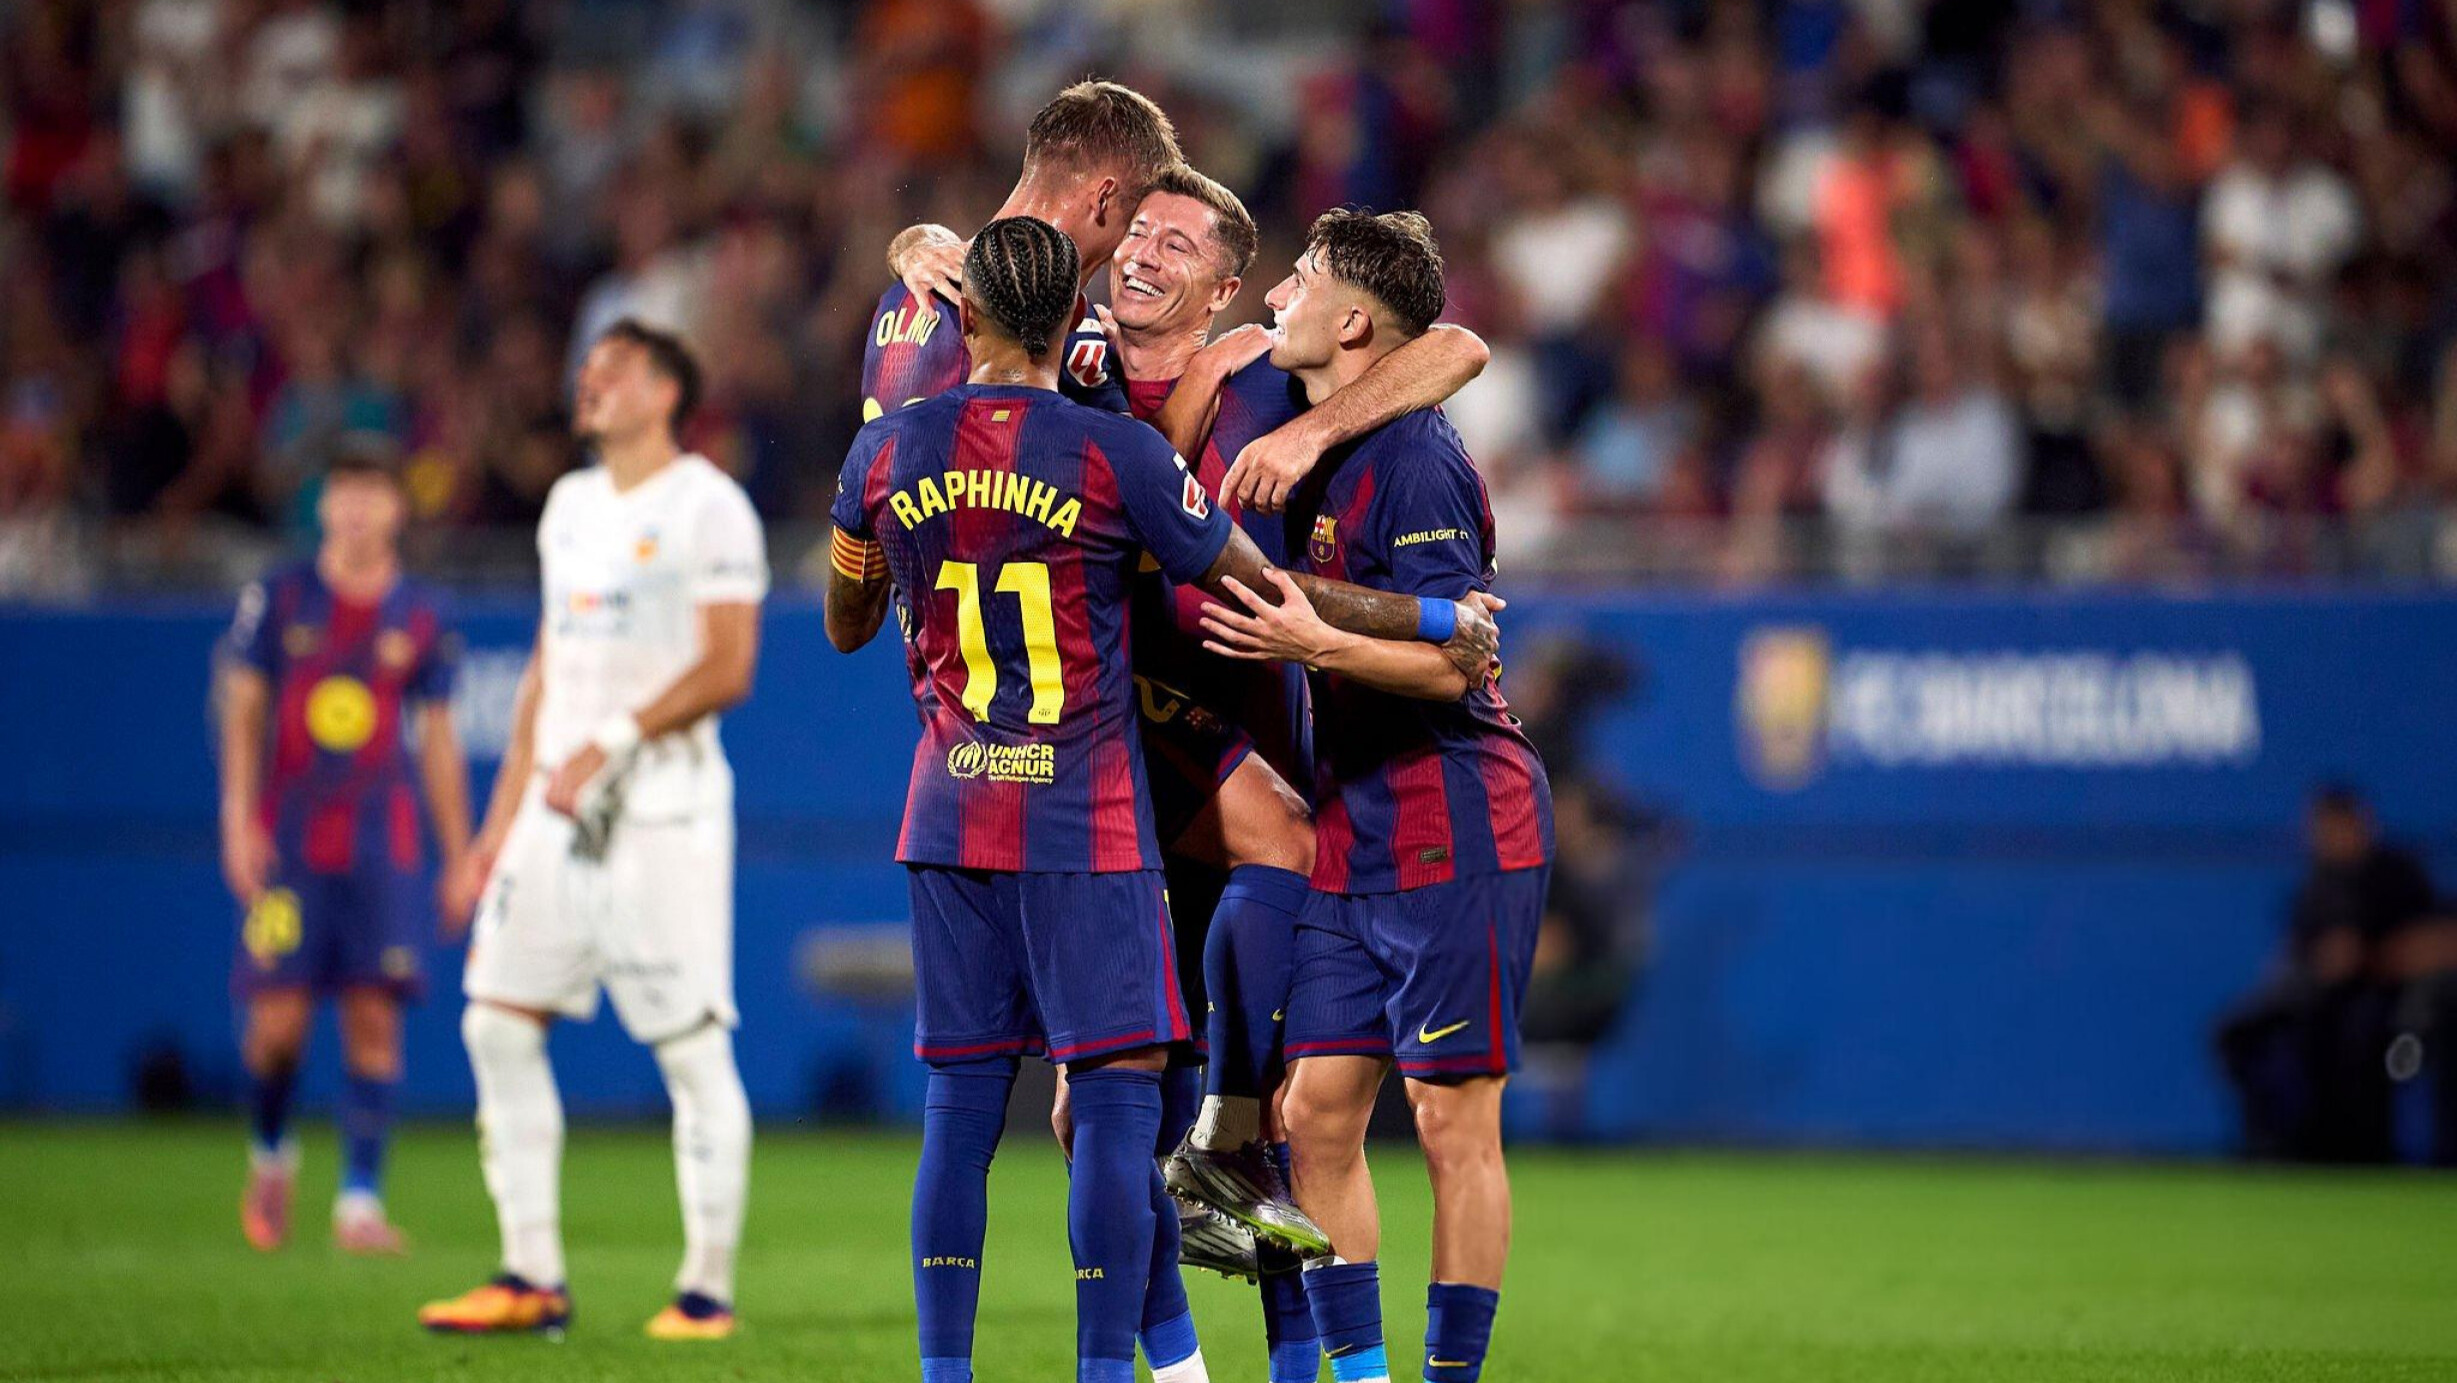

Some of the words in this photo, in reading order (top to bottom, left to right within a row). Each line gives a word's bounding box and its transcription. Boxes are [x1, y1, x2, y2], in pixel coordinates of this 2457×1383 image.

[876, 307, 940, 347] OLMO
[889, 470, 1082, 538] RAPHINHA
[1394, 529, 1457, 547] AMBILIGHT
[934, 560, 1064, 725] 11
[988, 743, 1054, 760] UNHCR
[987, 759, 1054, 776] ACNUR
[923, 1256, 975, 1269] BARÇA
